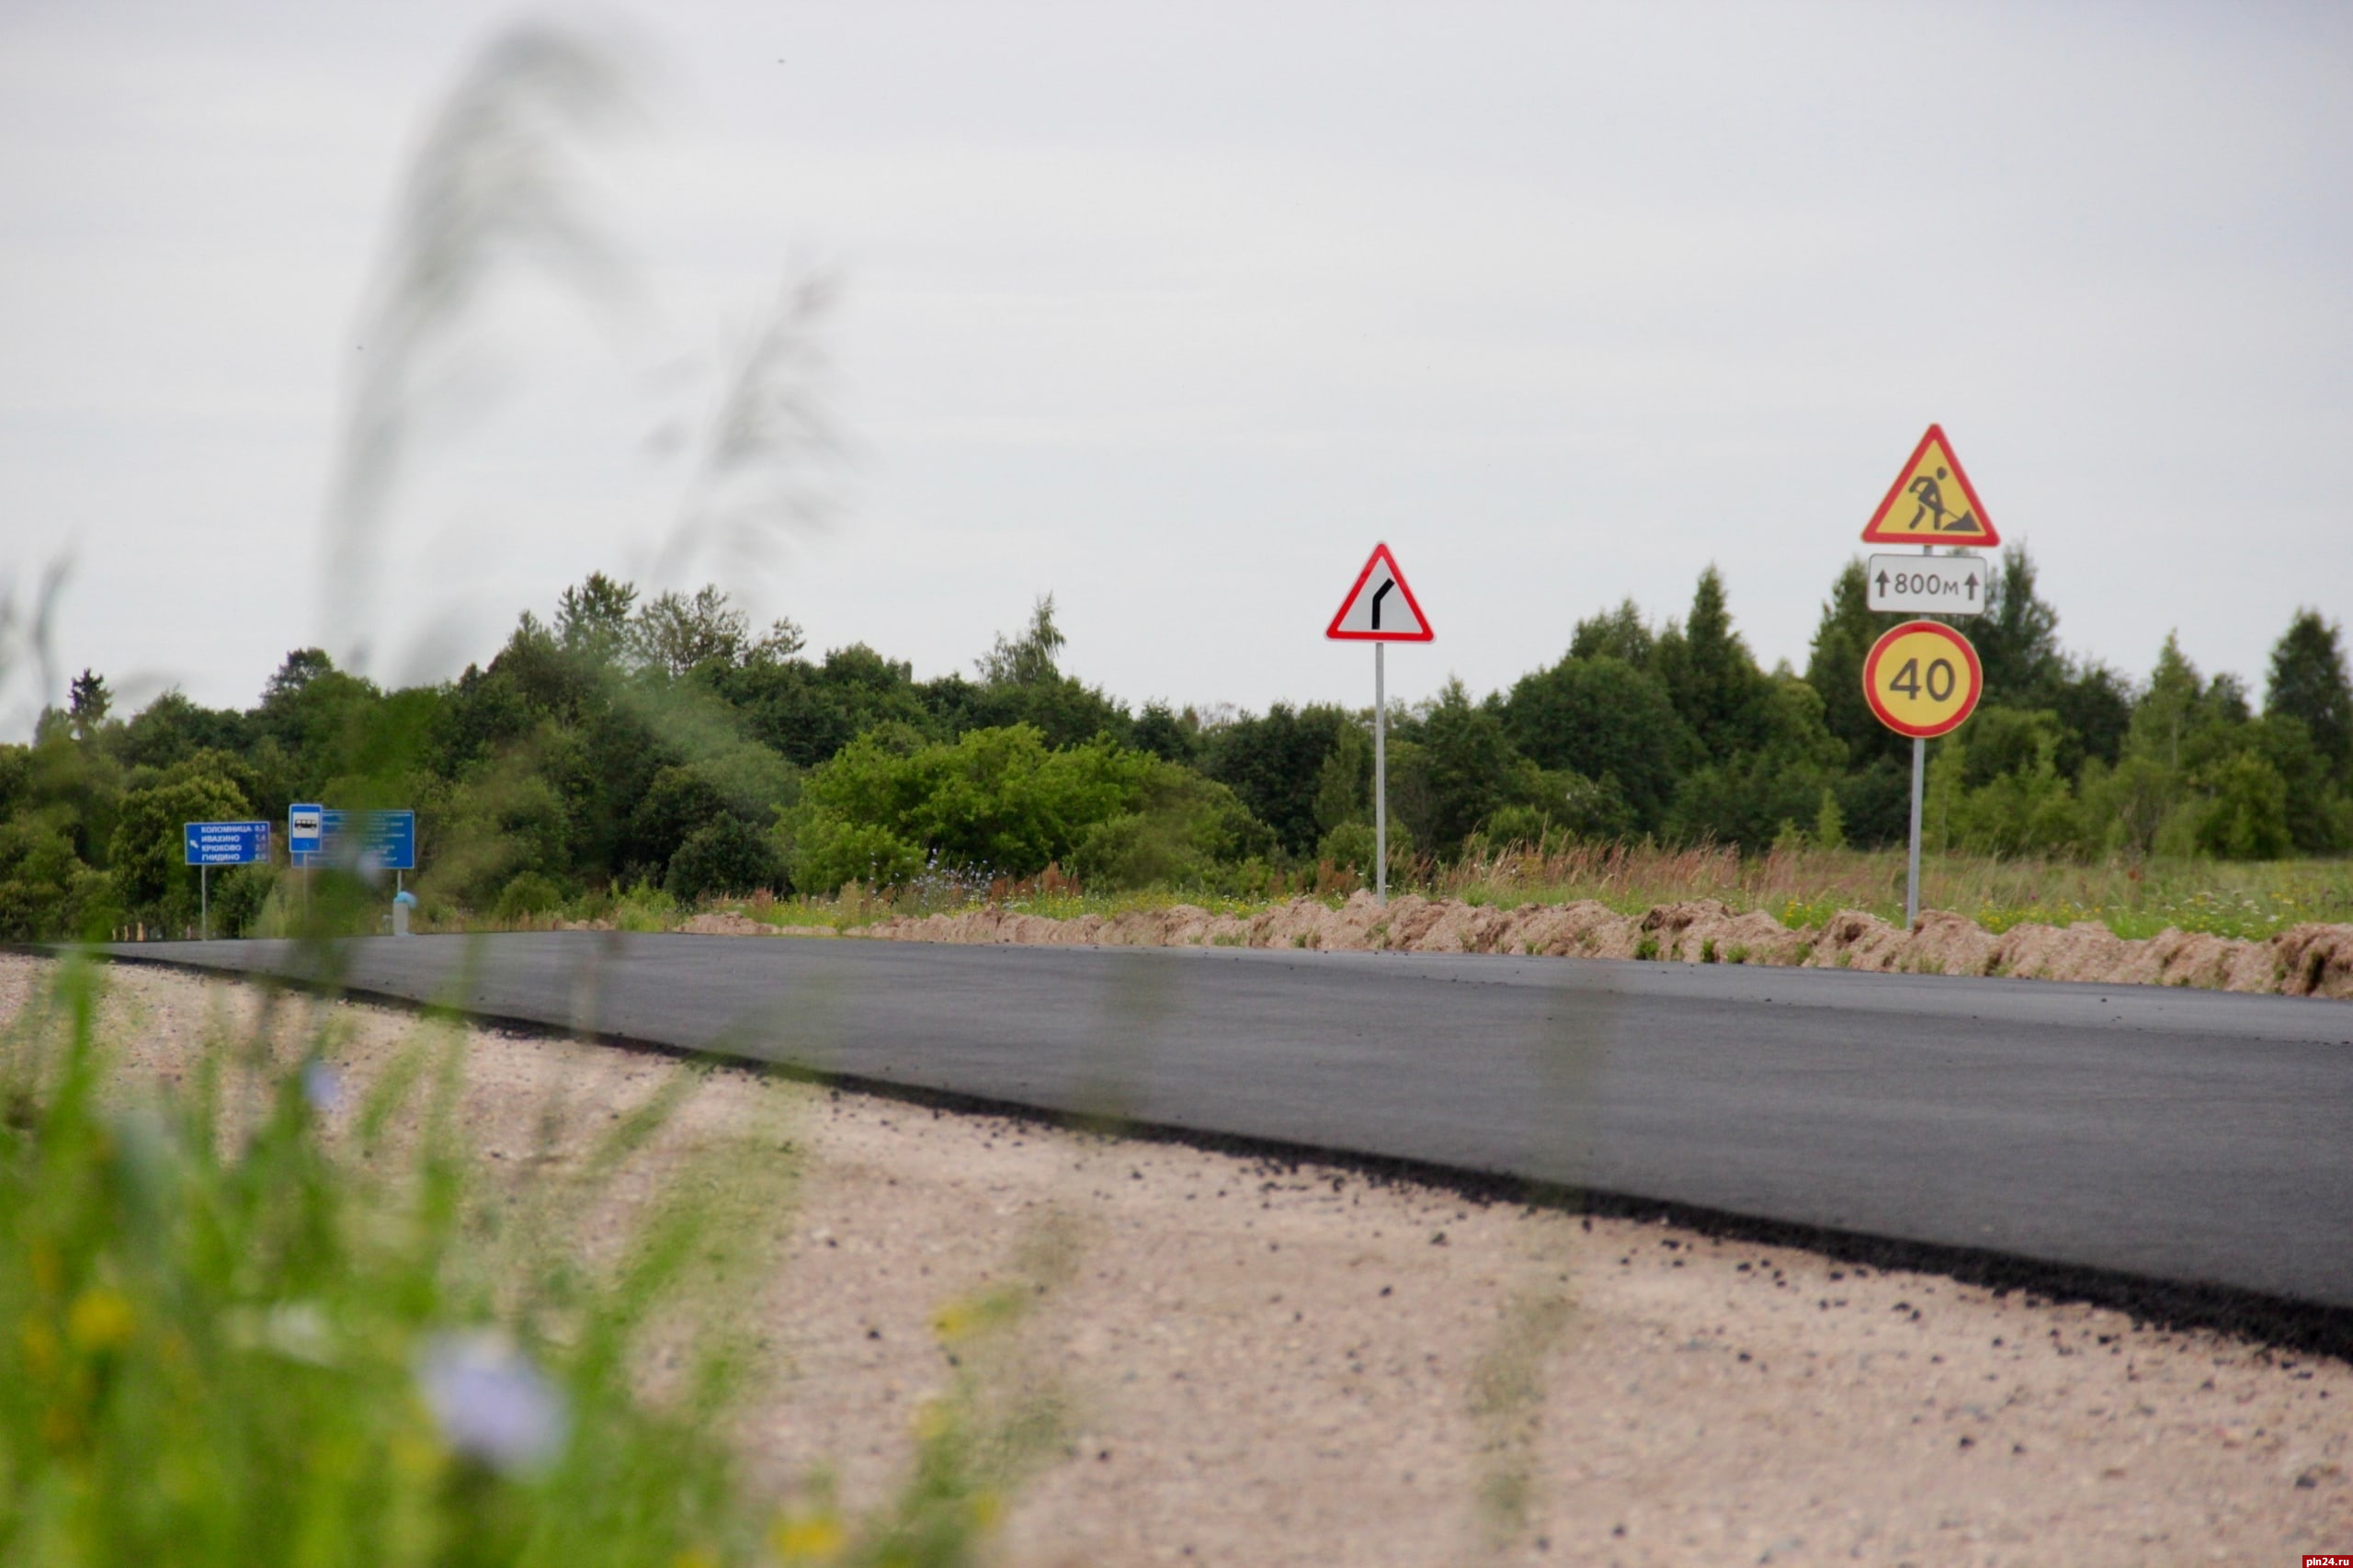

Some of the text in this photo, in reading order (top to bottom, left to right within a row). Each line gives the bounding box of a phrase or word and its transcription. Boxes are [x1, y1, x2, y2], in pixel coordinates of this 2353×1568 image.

[1890, 658, 1956, 701] 40
[201, 825, 253, 834] КОЛОМНИЦА
[201, 844, 243, 852] КРЮКОВО
[201, 853, 241, 861] ГНИДИНО
